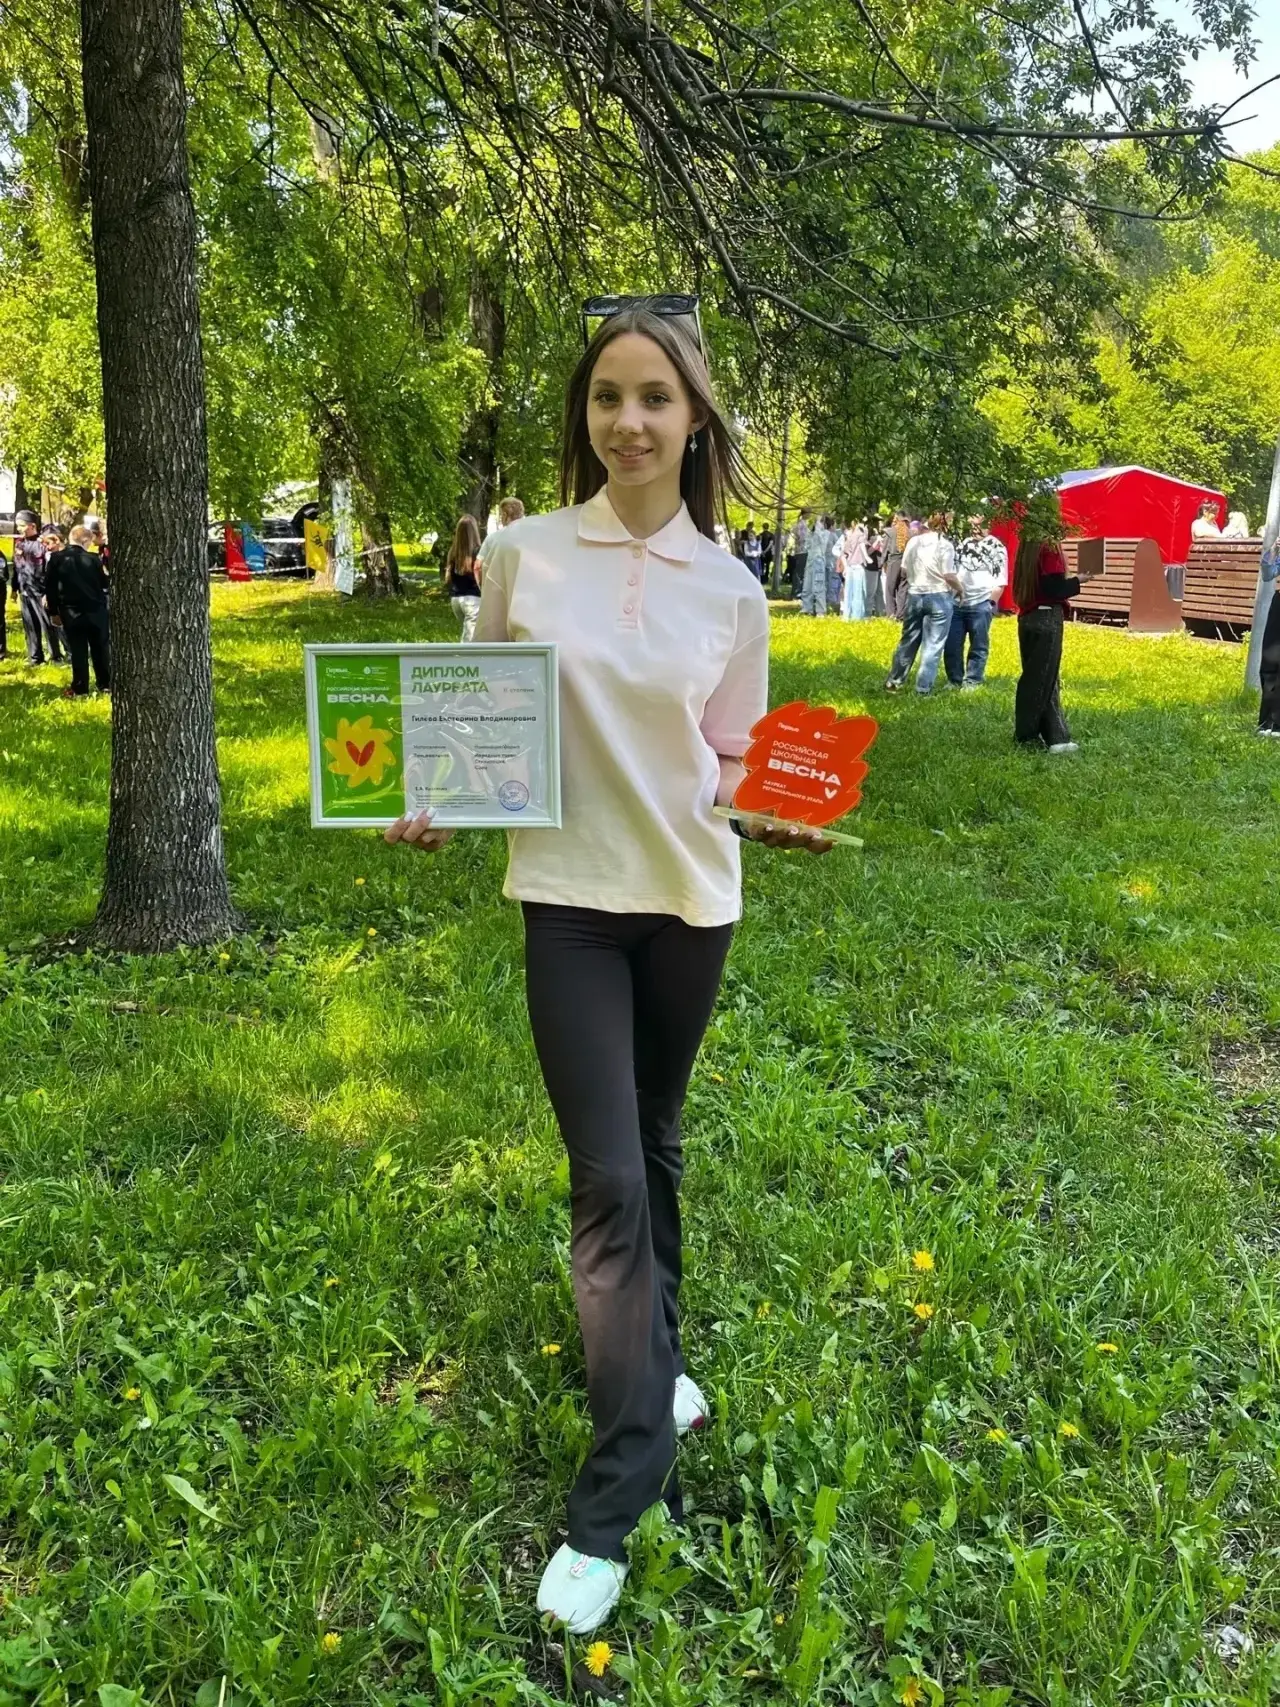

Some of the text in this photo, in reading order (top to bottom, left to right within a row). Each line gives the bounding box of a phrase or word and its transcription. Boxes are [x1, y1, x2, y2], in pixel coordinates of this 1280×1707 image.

[411, 666, 479, 680] ДИПЛОМ
[411, 681, 489, 693] ЛАУРЕАТА
[326, 693, 389, 704] ВЕСНА
[480, 715, 536, 723] Владимировна
[770, 749, 817, 765] ШКОЛЬНАЯ
[772, 740, 829, 760] РОССИЙСКАЯ
[767, 757, 842, 786] ВЕСНА
[763, 779, 787, 789] ЛАУРЕАТ
[762, 785, 824, 805] РЕГИОНАЛЬНОГО ЭТАПА
